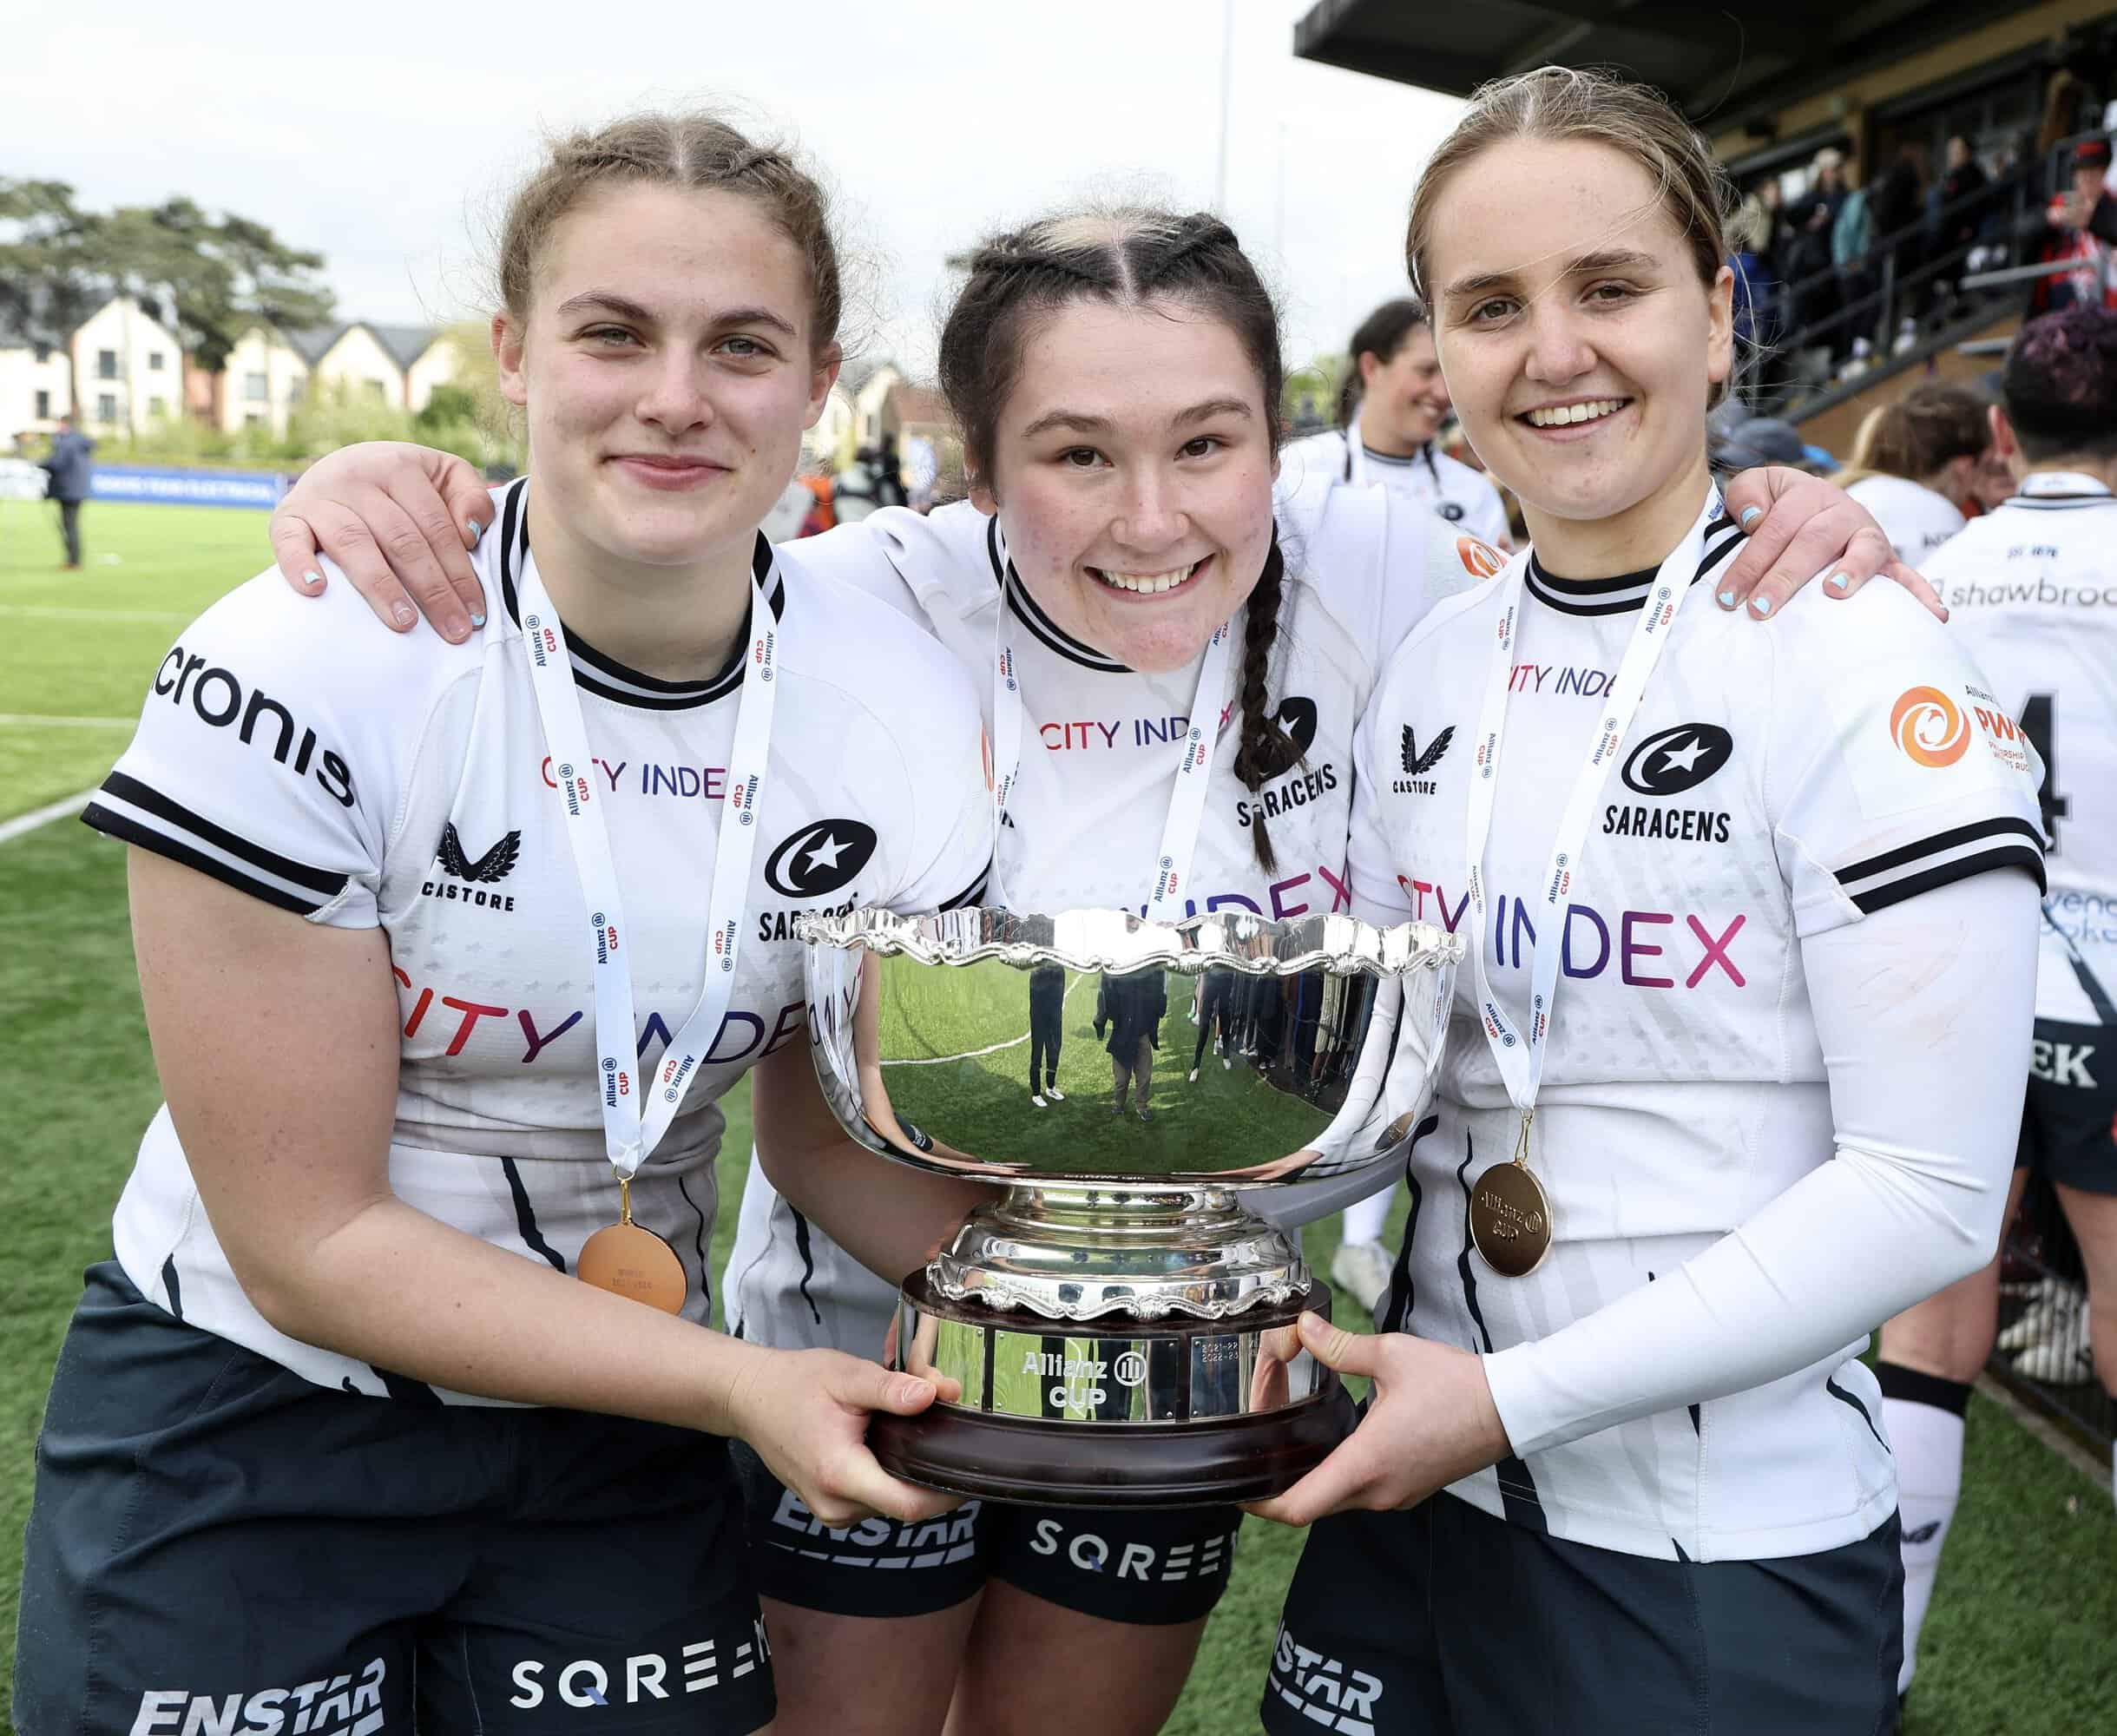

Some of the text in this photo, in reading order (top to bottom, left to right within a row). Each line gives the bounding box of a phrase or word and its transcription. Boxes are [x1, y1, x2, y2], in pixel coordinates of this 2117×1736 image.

[1646, 601, 1665, 634] Allianz
[1660, 604, 1673, 626] CUP
[533, 630, 547, 667] Allianz
[543, 628, 557, 653] CUP
[755, 639, 765, 664] CUP
[766, 631, 775, 666] Allianz
[1005, 646, 1014, 679] Allianz
[1509, 664, 1554, 694] ITY
[152, 646, 355, 807] cronis
[1040, 720, 1121, 751] CITY
[1183, 742, 1199, 773] Allianz
[1195, 744, 1206, 766] CUP
[1476, 744, 1486, 766] CUP
[1485, 733, 1496, 766] Allianz
[1592, 732, 1610, 766] Allianz
[1606, 734, 1618, 756] CUP
[576, 777, 590, 802] CUP
[642, 763, 726, 799] INDE
[733, 784, 744, 809] CUP
[744, 774, 759, 811] Allianz
[1392, 779, 1437, 795] CASTORE
[565, 779, 581, 816] Allianz
[1602, 805, 1732, 844] SARACENS
[421, 881, 516, 912] CASTORE
[1154, 870, 1168, 902] Allianz
[1167, 872, 1178, 895] CUP
[1548, 868, 1563, 904] Allianz
[1560, 871, 1570, 895] CUP
[597, 928, 608, 964] Allianz
[607, 925, 619, 951] CUP
[714, 930, 724, 955] CUP
[724, 919, 737, 956] Allianz
[391, 963, 584, 1064] ITY
[1485, 1003, 1507, 1036] Allianz
[1485, 1016, 1499, 1039] CUP
[1532, 1009, 1542, 1045] Allianz
[1538, 1013, 1547, 1038] CUP
[619, 1071, 630, 1096] CUP
[662, 1059, 678, 1083] CUP
[672, 1054, 695, 1088] Allianz
[606, 1072, 618, 1108] Allianz
[1022, 1351, 1108, 1380] Allianz
[1049, 1385, 1108, 1410] CUP
[1029, 1519, 1238, 1581] SQREE
[1274, 1618, 1384, 1720] STAR
[129, 1657, 386, 1736] ENSTAR
